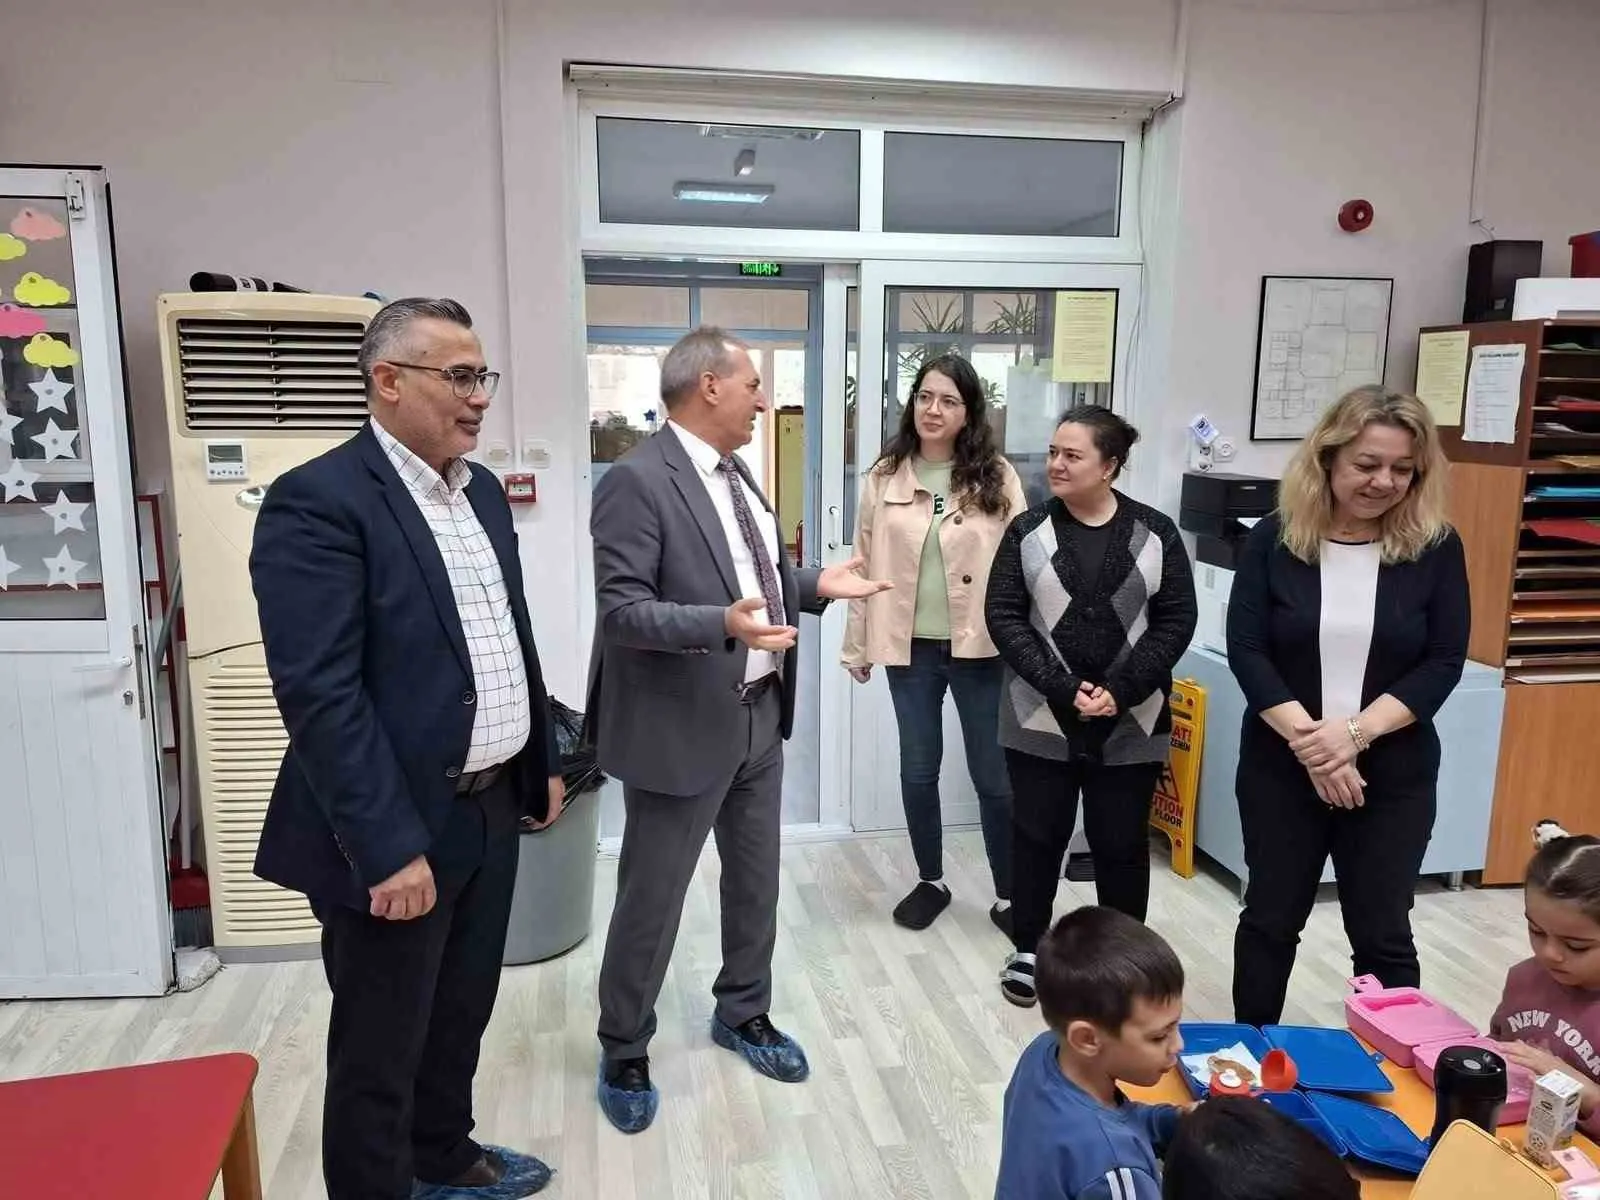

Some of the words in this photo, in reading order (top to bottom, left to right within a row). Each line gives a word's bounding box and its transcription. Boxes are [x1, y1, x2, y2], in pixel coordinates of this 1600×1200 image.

[1152, 794, 1184, 818] UTION
[1155, 808, 1183, 828] FLOOR
[1507, 1009, 1551, 1033] NEW
